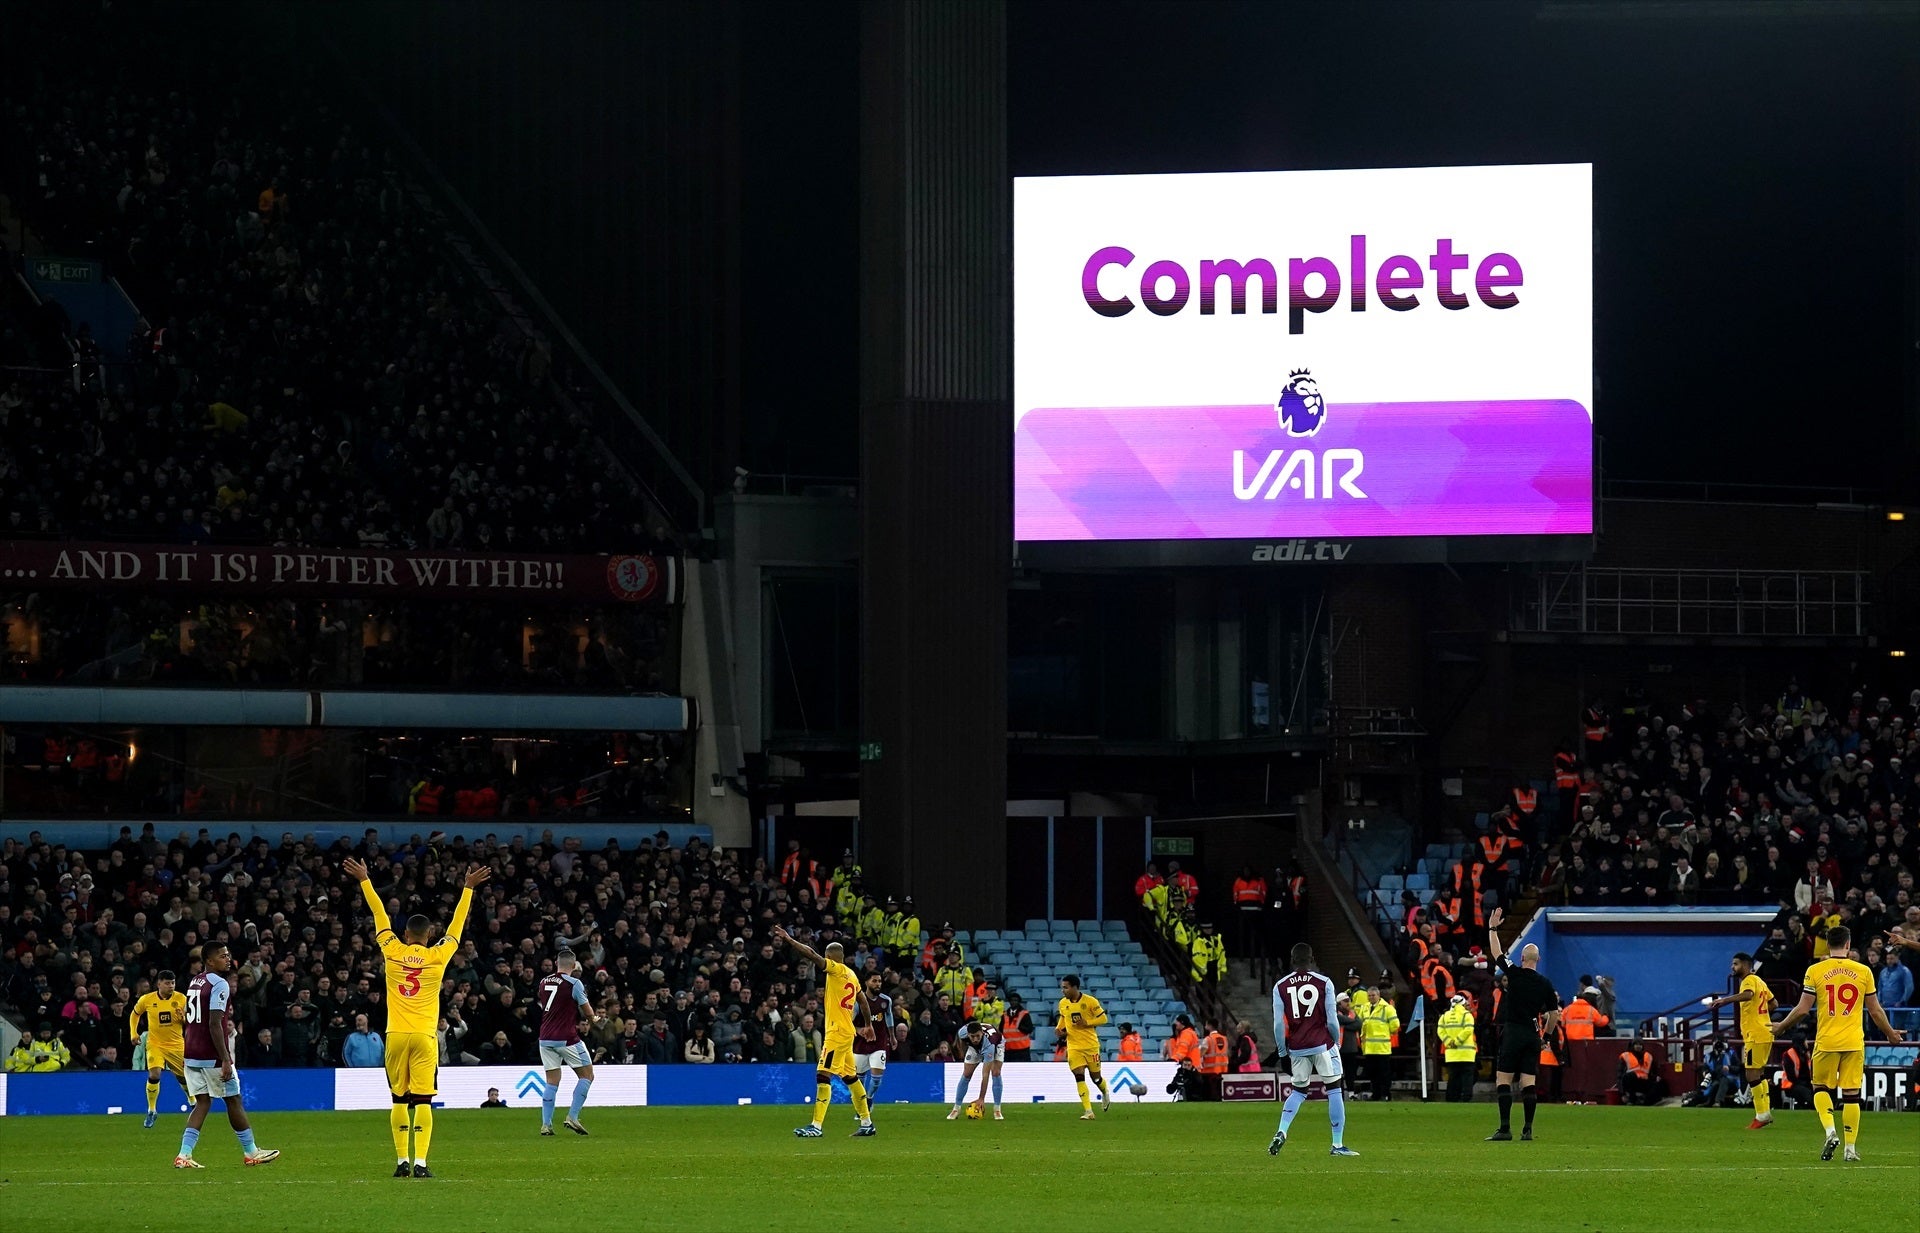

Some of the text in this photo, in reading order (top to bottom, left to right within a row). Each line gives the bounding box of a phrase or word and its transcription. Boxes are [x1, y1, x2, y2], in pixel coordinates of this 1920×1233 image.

[63, 266, 89, 279] EXIT
[1082, 235, 1524, 335] Complete
[1232, 448, 1368, 500] VAR
[1252, 539, 1352, 561] adi.tv
[50, 550, 142, 580] AND
[155, 552, 197, 581] IT
[210, 553, 257, 583] IS!
[271, 554, 398, 586] PETER
[406, 558, 564, 589] WITHE!!
[398, 966, 423, 997] 3
[1289, 975, 1313, 985] DIABY
[1823, 967, 1858, 981] ROBINSON
[186, 989, 202, 1024] 31
[544, 985, 558, 1012] 7
[841, 982, 856, 1010] 2
[1286, 984, 1319, 1019] 19
[1825, 983, 1859, 1017] 19
